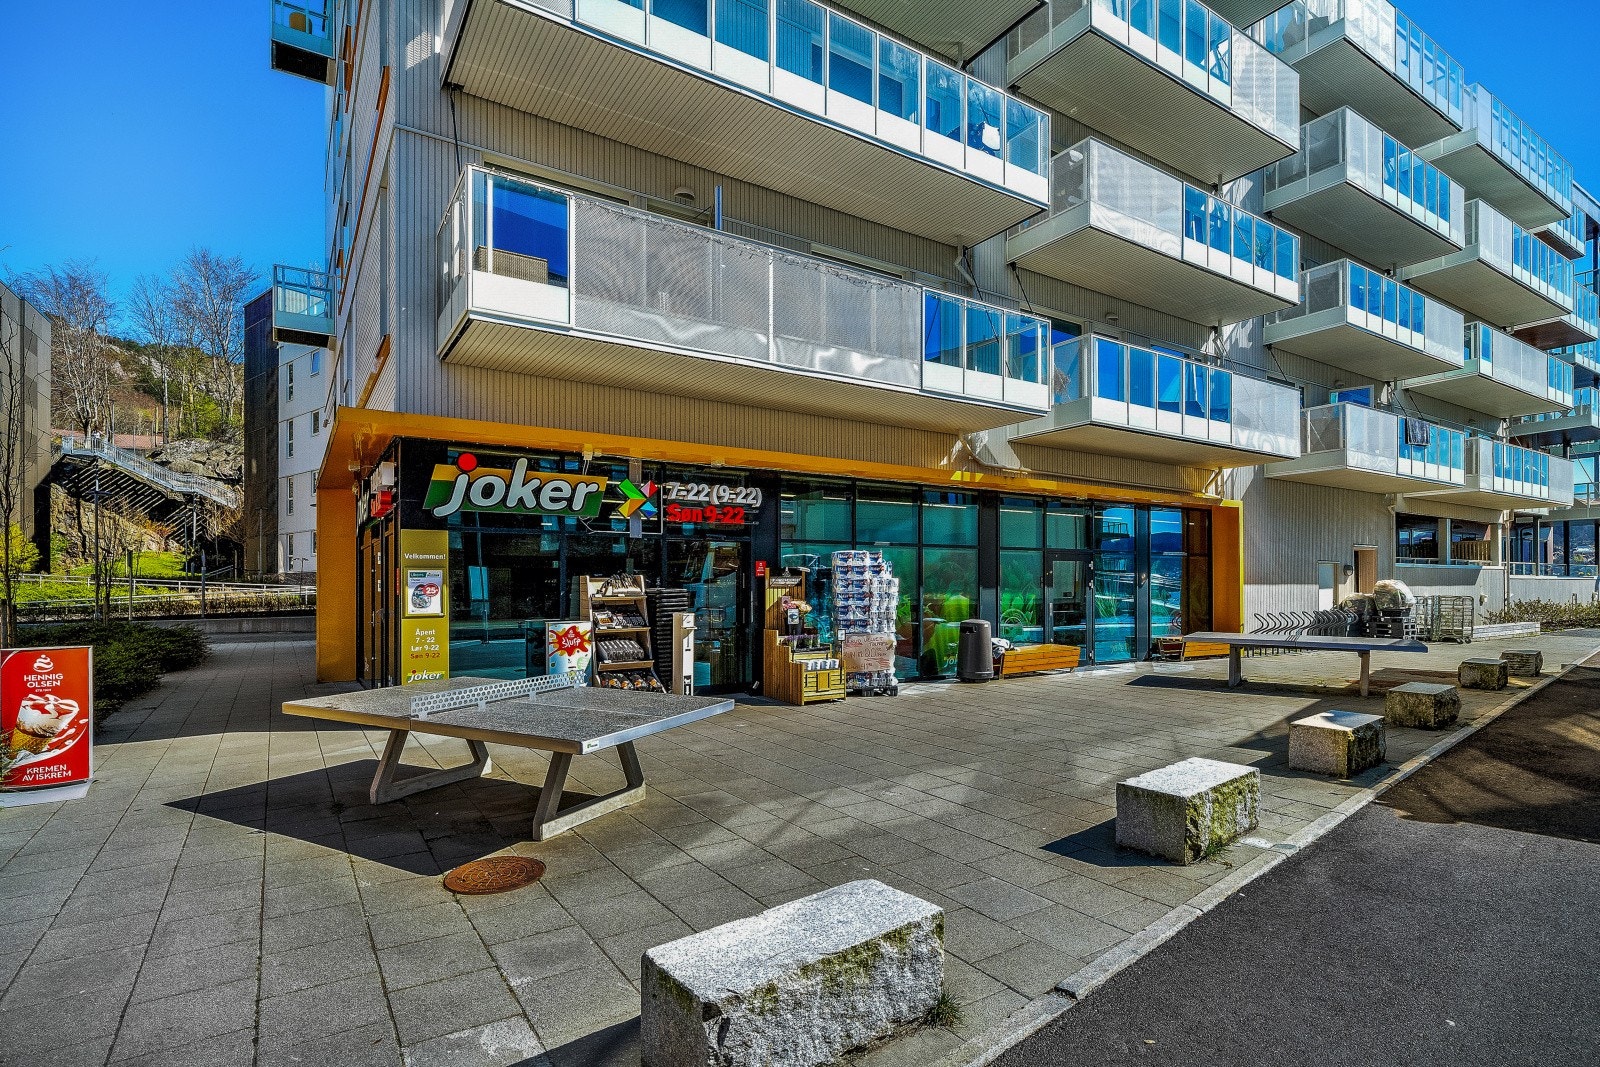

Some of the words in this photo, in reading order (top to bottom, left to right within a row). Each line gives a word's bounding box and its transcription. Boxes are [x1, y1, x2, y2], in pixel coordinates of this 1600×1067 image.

[433, 452, 599, 516] joker
[667, 482, 709, 501] 7-22
[711, 484, 762, 507] (9-22)
[667, 503, 702, 522] Søn
[704, 506, 744, 524] 9-22
[415, 628, 436, 636] Åpent
[23, 673, 64, 682] HENNIG
[407, 669, 442, 683] joker
[26, 680, 61, 688] OLSEN
[26, 764, 67, 775] KREMEN
[22, 774, 34, 782] AV
[36, 770, 72, 781] ISKREM
